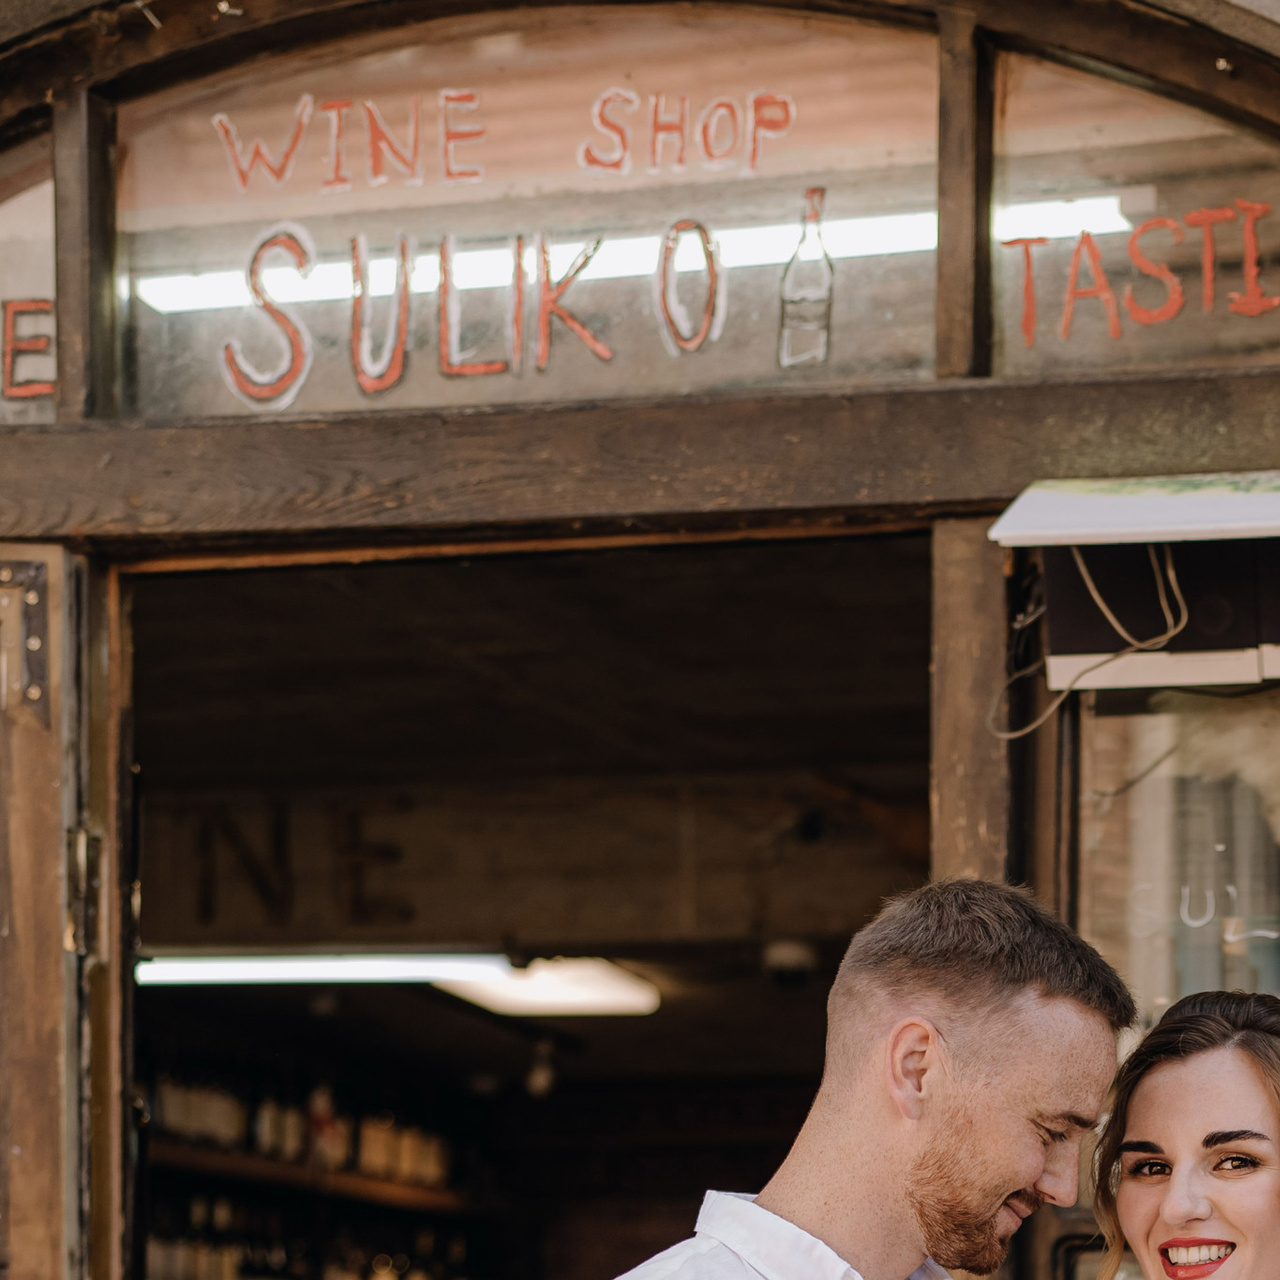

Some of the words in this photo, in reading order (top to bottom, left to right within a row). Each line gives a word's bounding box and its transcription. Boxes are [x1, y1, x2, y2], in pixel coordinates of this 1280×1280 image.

[212, 88, 487, 192] WINE
[577, 87, 796, 175] SHOP
[221, 218, 731, 412] SULIKO
